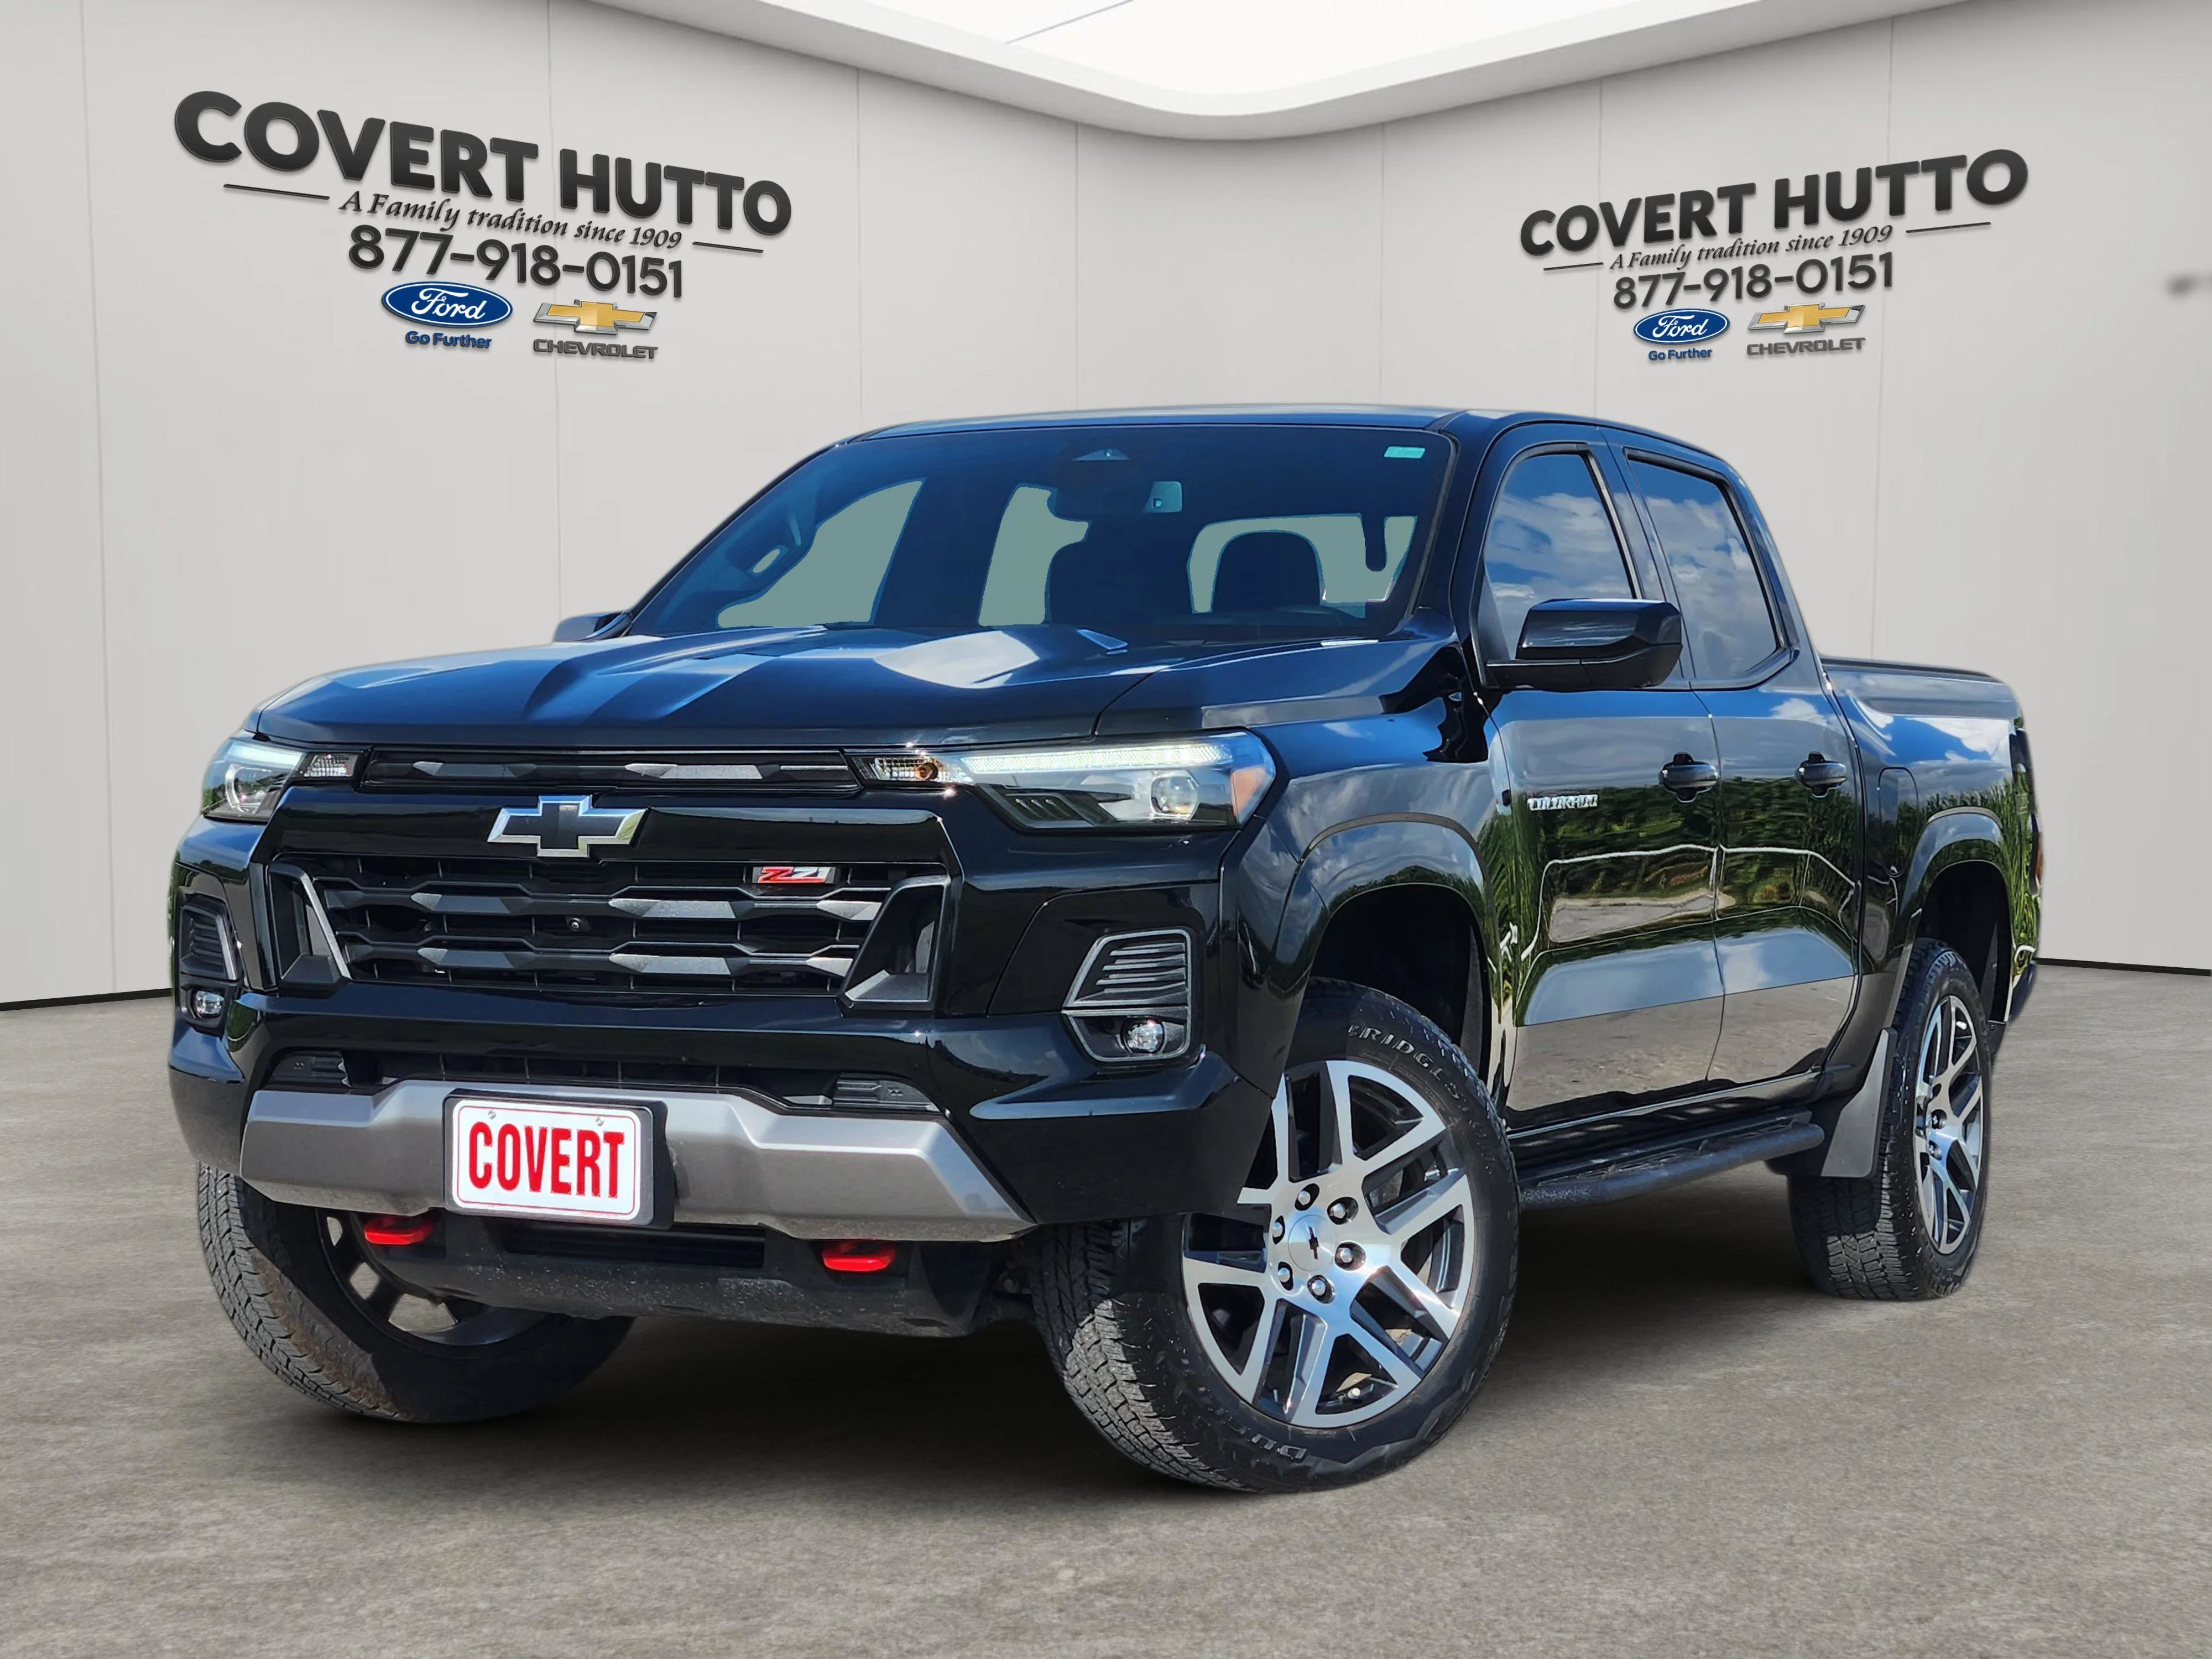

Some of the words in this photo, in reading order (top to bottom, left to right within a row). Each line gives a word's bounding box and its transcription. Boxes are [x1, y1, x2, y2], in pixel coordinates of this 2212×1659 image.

[175, 91, 538, 201] COVERT
[560, 148, 791, 236] HUTTO
[339, 191, 362, 212] A
[368, 193, 460, 231] Family
[468, 208, 566, 236] tradition
[574, 221, 625, 243] since
[629, 227, 682, 248] 1909
[1520, 182, 1755, 255] COVERT
[1775, 149, 2028, 228] HUTTO
[348, 225, 682, 298] 877-918-0151
[1610, 253, 1624, 270] A
[1626, 244, 1692, 270] Family
[1697, 238, 1778, 260] tradition
[1786, 233, 1833, 252] since
[1838, 225, 1893, 246] 1909
[1614, 252, 1892, 309] 877-918-0151
[411, 288, 487, 320] Ford
[406, 331, 431, 346] Go
[433, 332, 492, 349] Further
[1652, 315, 1707, 338] Ford
[534, 338, 658, 359] CHEVROLET
[1648, 350, 1666, 361] Go
[1668, 348, 1712, 359] Further
[1747, 337, 1865, 355] CHEVROLET
[758, 867, 831, 884] Z71
[469, 1121, 624, 1198] COVERT
